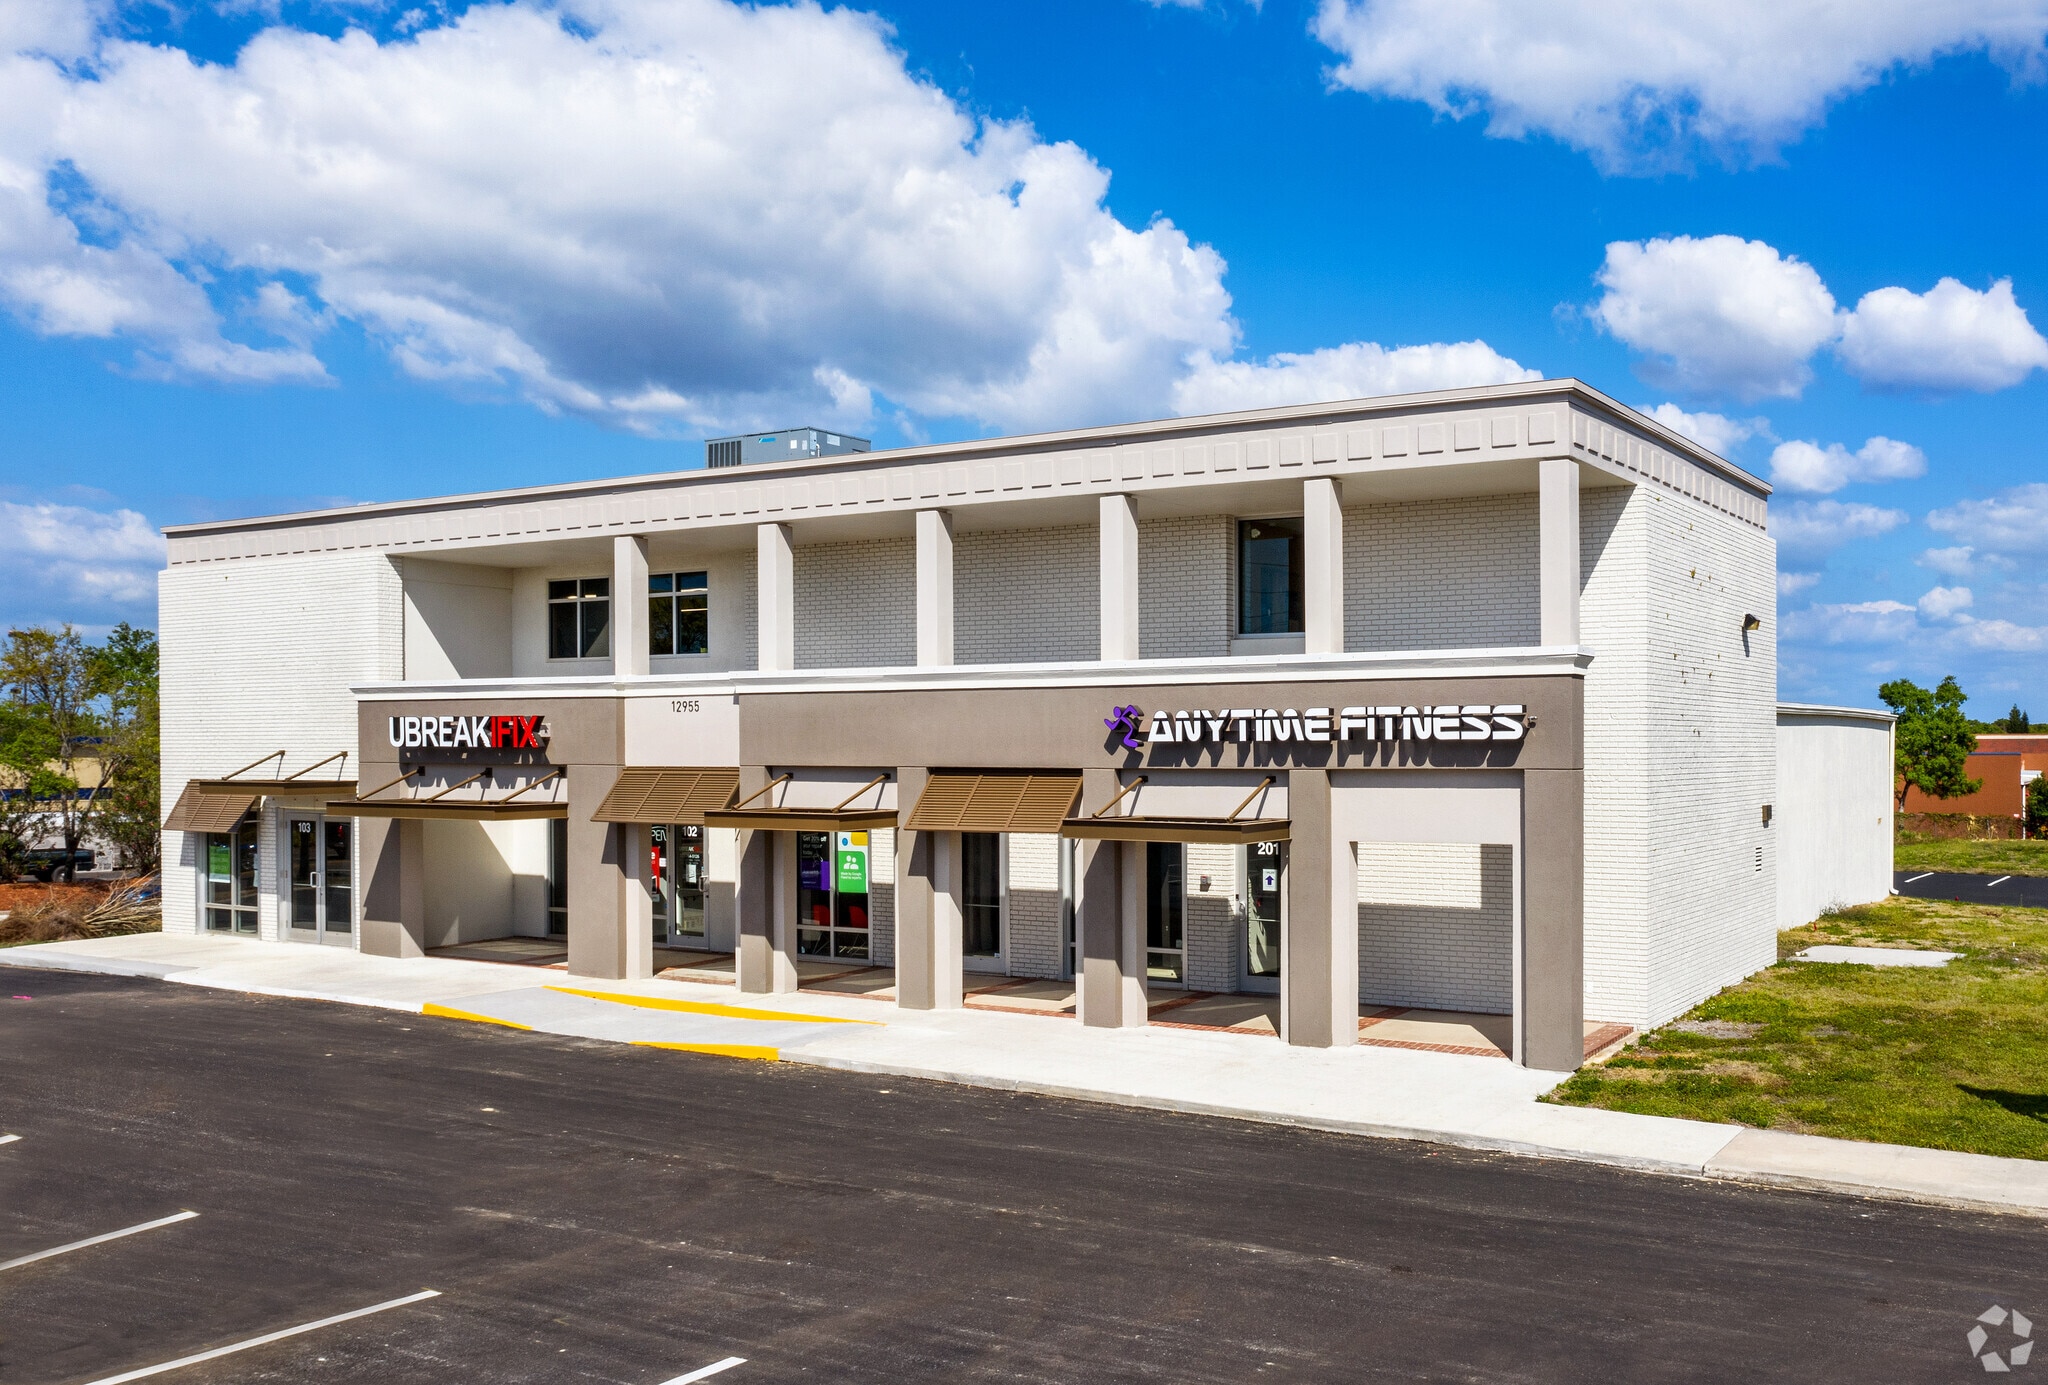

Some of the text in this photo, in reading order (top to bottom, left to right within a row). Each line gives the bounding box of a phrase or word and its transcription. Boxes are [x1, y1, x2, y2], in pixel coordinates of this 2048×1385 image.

[672, 700, 700, 713] 12955
[1147, 704, 1524, 743] ANYTIME FITNESS
[388, 715, 539, 749] UBREAKIFIX
[298, 822, 311, 833] 103
[682, 826, 698, 837] 102
[651, 829, 668, 842] PEN
[1257, 842, 1279, 855] 201
